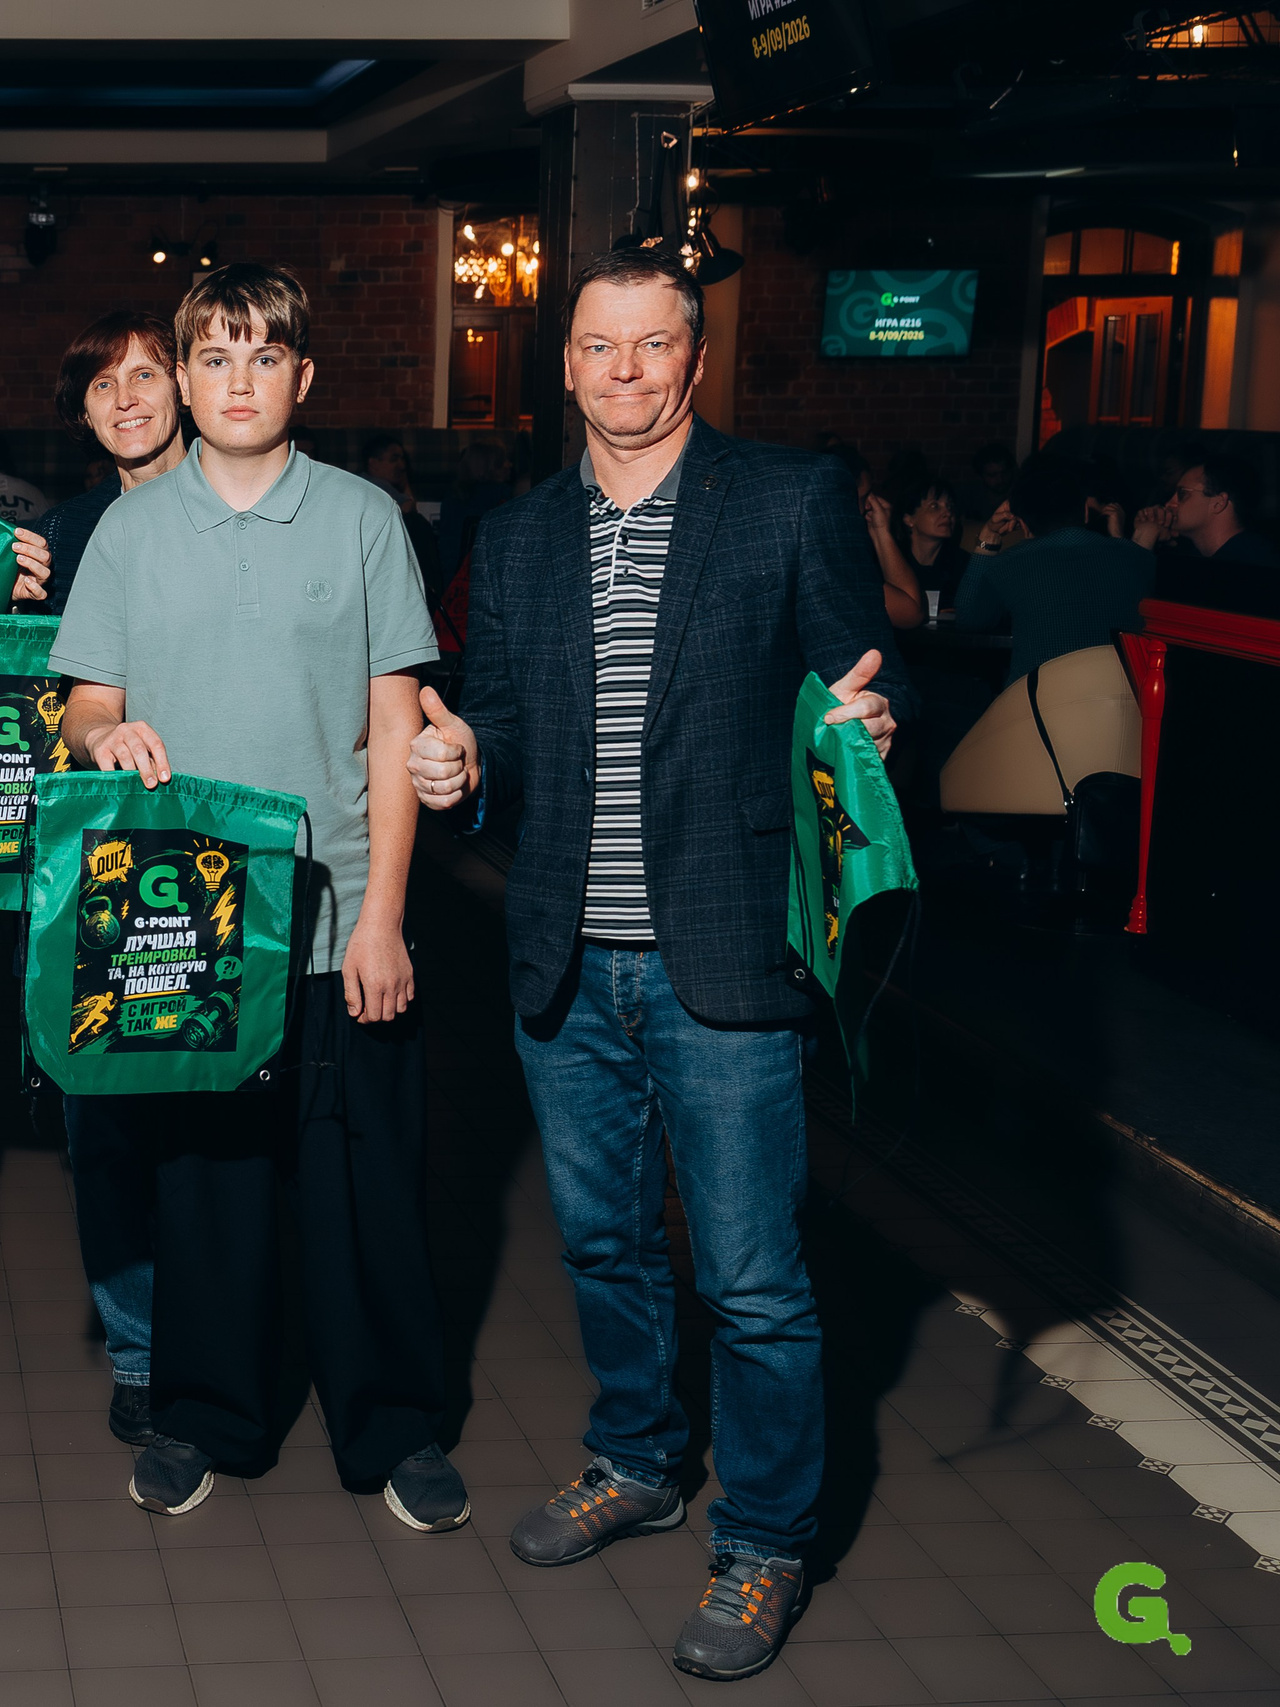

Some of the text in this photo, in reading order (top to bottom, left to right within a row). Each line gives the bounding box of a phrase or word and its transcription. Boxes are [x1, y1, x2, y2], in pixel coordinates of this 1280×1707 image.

[752, 15, 810, 59] 8-9/09/2026
[875, 318, 898, 328] ИГРА
[124, 931, 196, 953] ЛУЧШАЯ
[111, 948, 197, 967] ТРЕНИРОВКА
[128, 966, 144, 978] НА
[148, 961, 207, 976] КОТОРУЮ
[140, 996, 186, 1016] ИГРОЙ
[127, 1015, 178, 1032] ТАК ЖЕ
